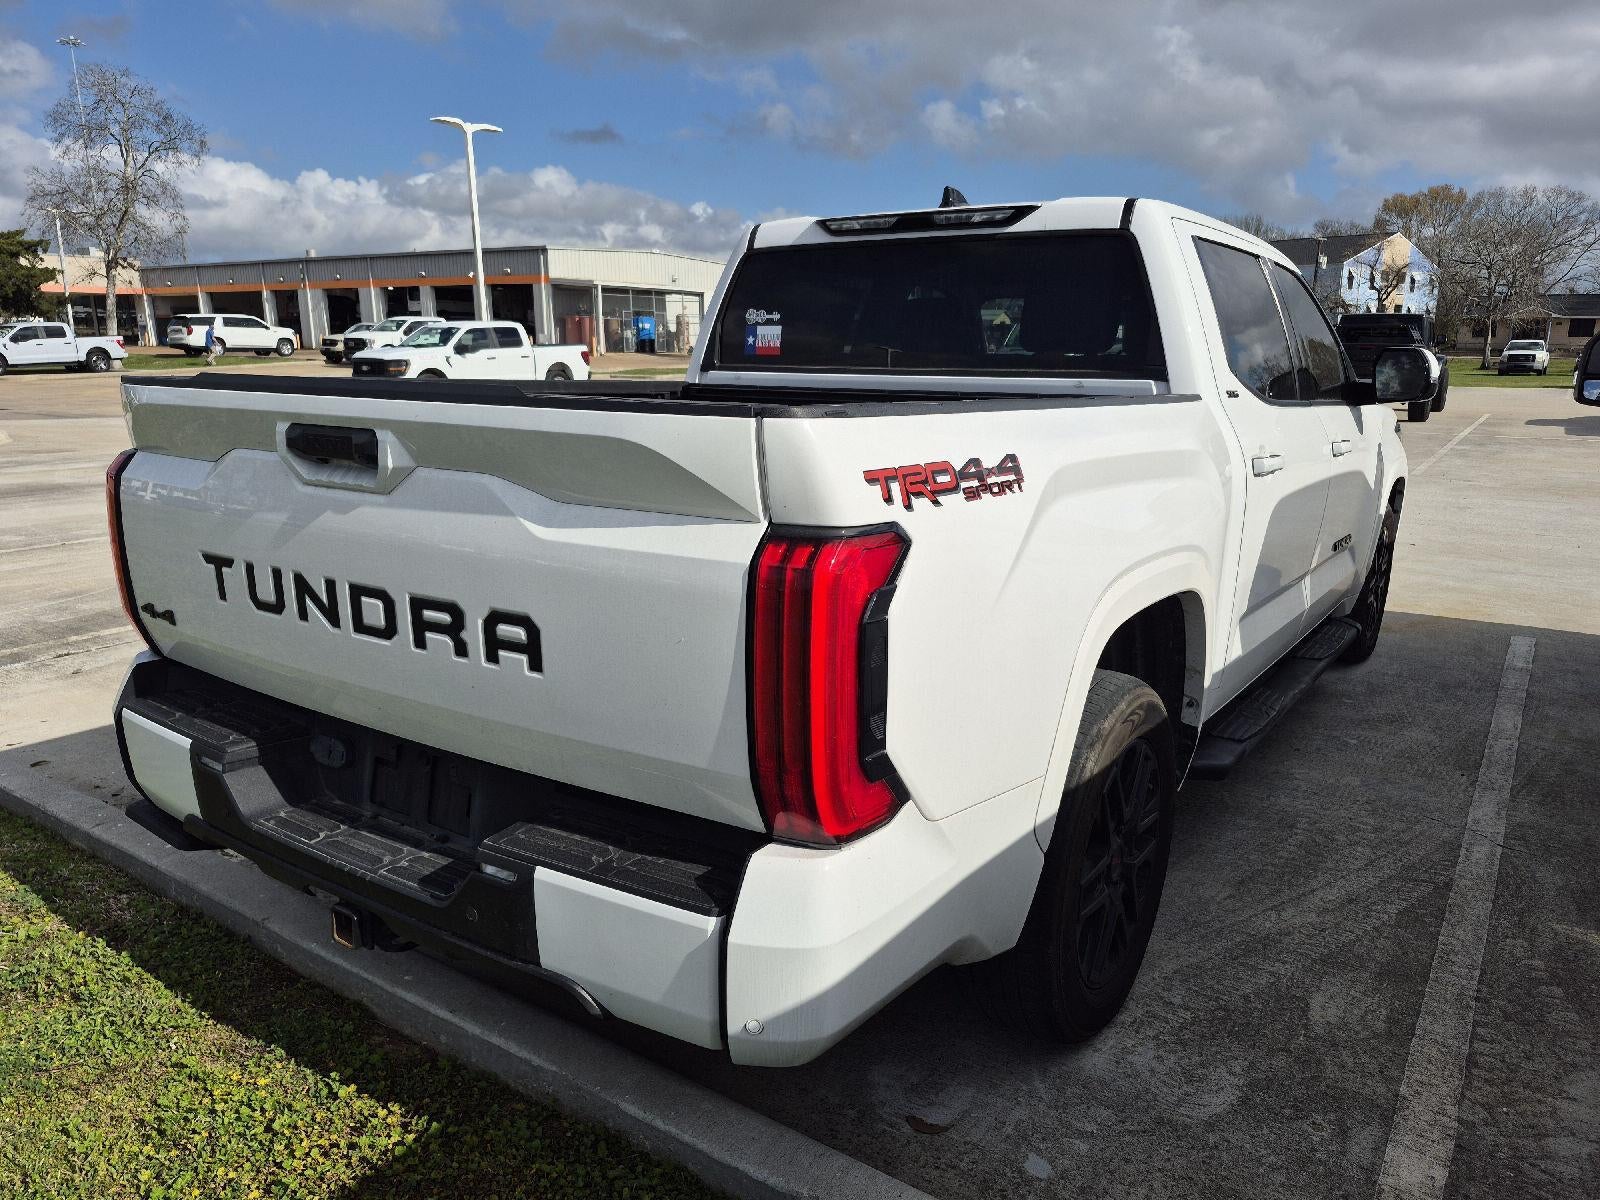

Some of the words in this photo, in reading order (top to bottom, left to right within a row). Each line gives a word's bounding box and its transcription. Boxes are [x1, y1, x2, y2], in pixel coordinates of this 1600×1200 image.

[863, 461, 961, 512] TRD
[962, 478, 1024, 502] SPORT
[201, 551, 543, 678] TUNDRA
